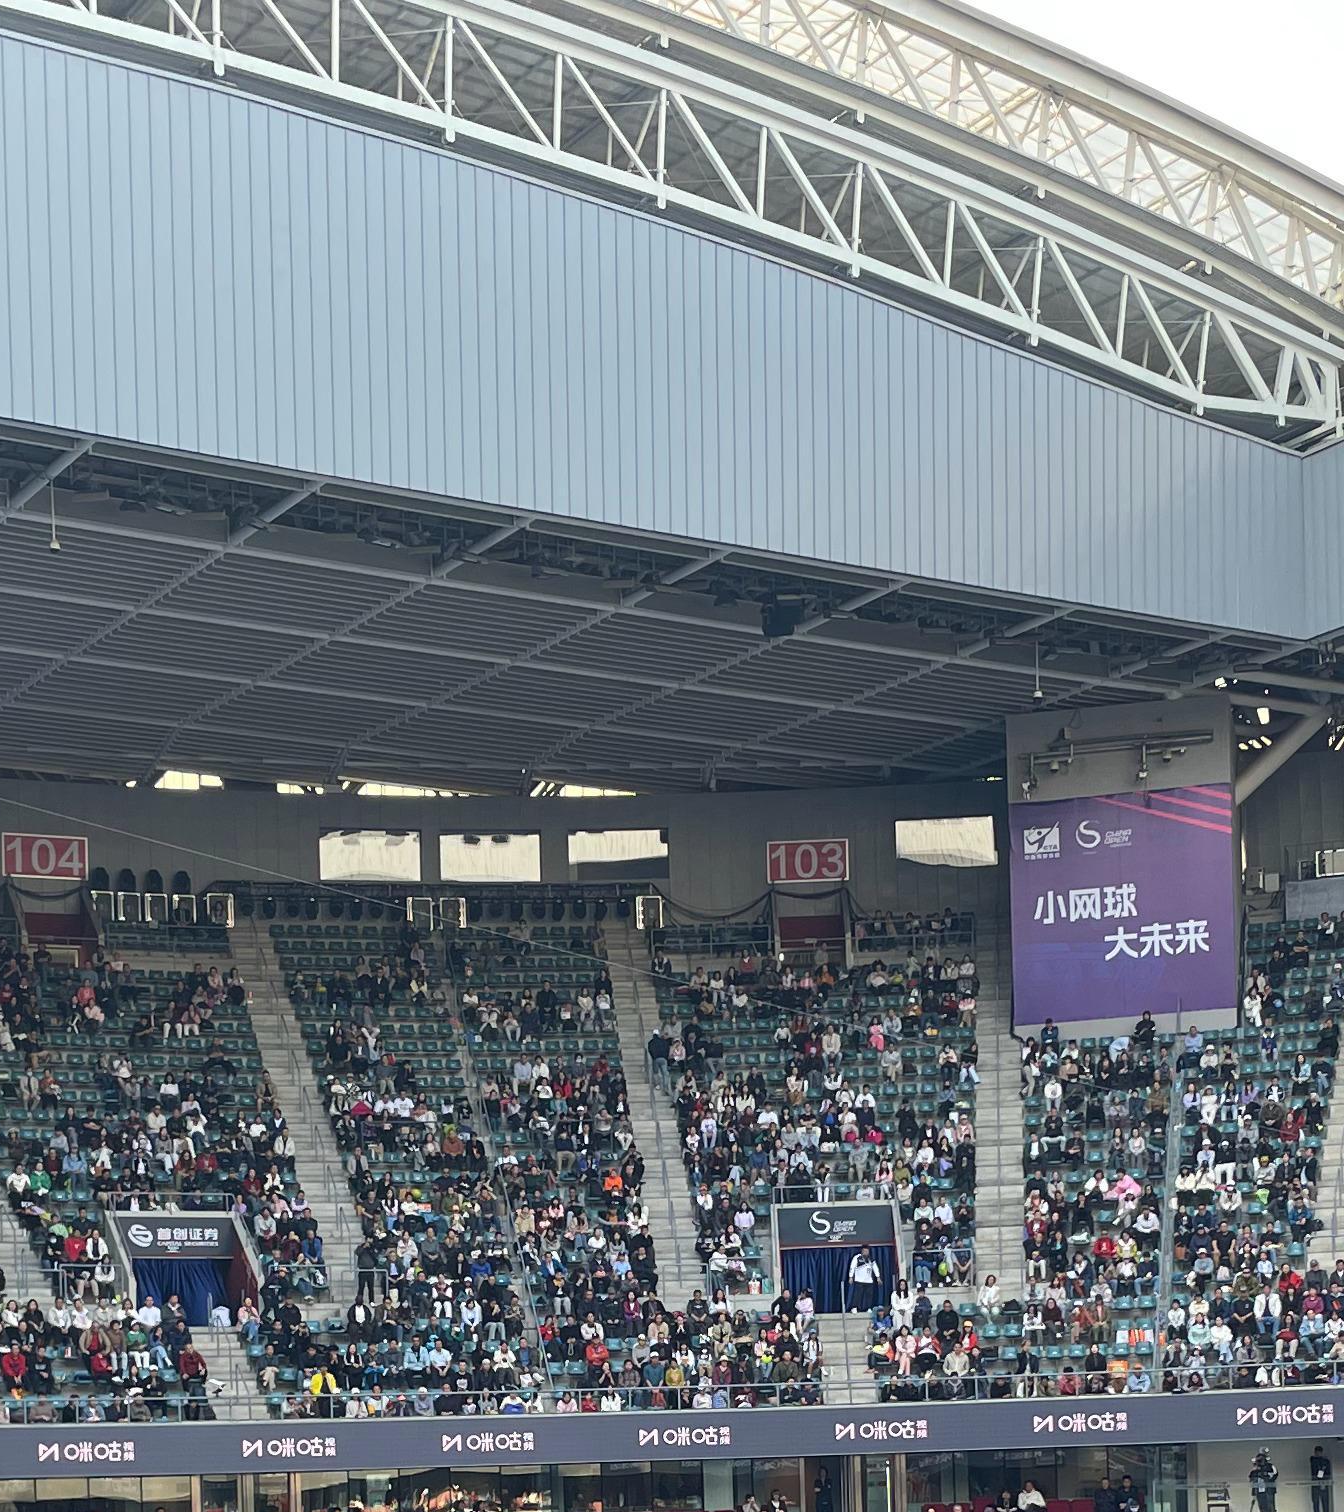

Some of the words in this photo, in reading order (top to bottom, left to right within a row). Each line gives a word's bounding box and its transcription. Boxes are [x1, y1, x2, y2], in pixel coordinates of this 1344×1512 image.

[6, 837, 84, 878] 104
[771, 843, 844, 879] 103
[1033, 882, 1138, 925] 小网球
[1104, 919, 1210, 961] 大未来
[156, 1227, 219, 1241] 首创证券
